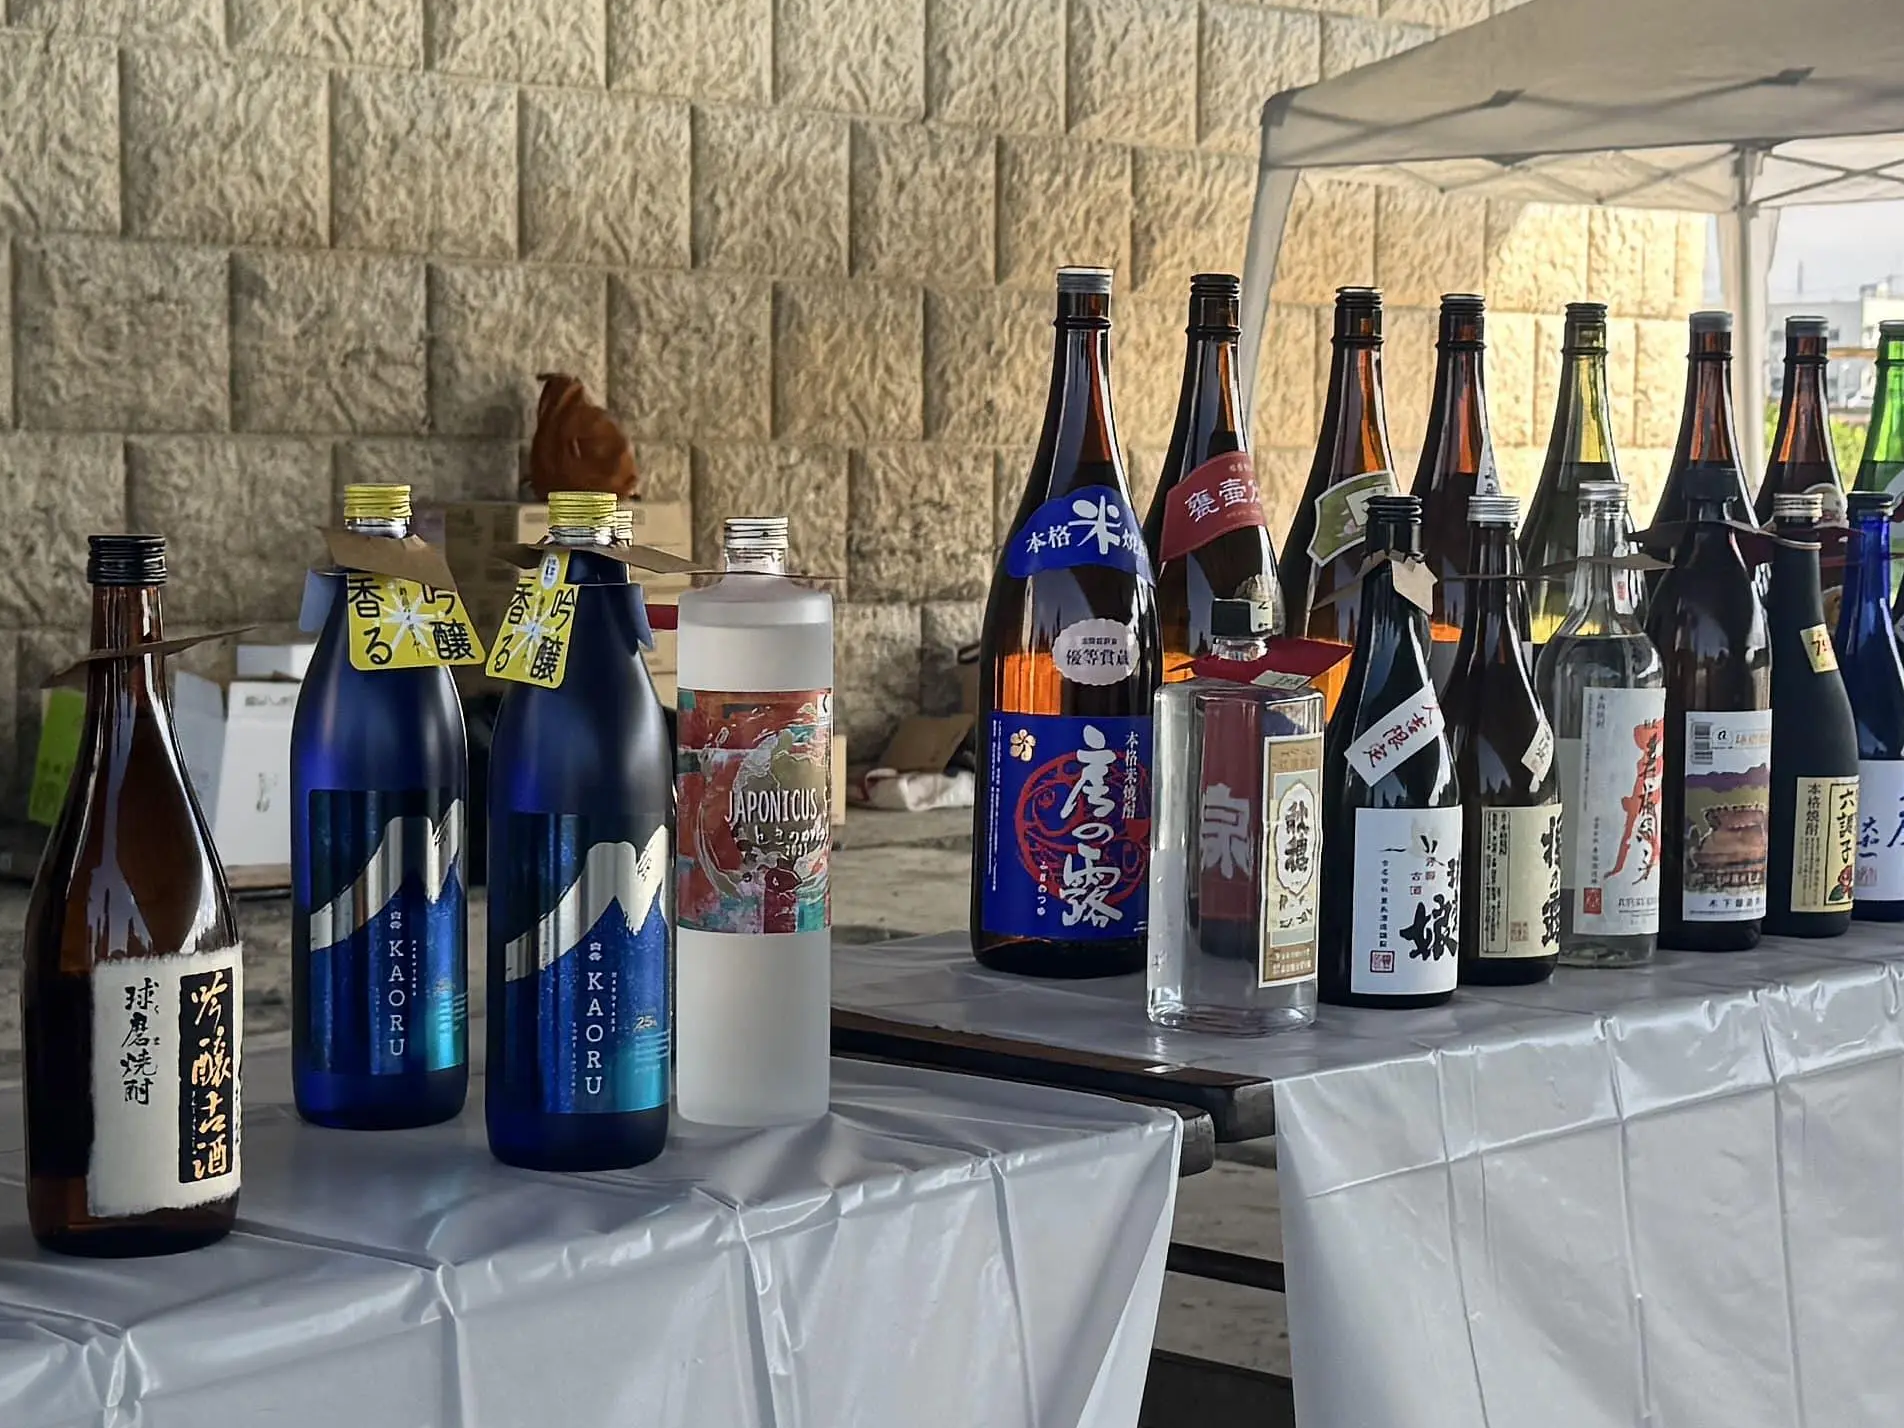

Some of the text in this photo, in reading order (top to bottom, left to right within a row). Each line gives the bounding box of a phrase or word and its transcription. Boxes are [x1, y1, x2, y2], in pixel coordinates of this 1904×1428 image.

[349, 578, 393, 665] 香る
[530, 588, 577, 683] 吟醸
[724, 787, 818, 823] JAPONICUS
[119, 977, 159, 1106] 球磨焼酎
[389, 939, 405, 1056] KAORU
[585, 972, 603, 1095] KAORU
[191, 971, 232, 1180] 吟醸古酒
